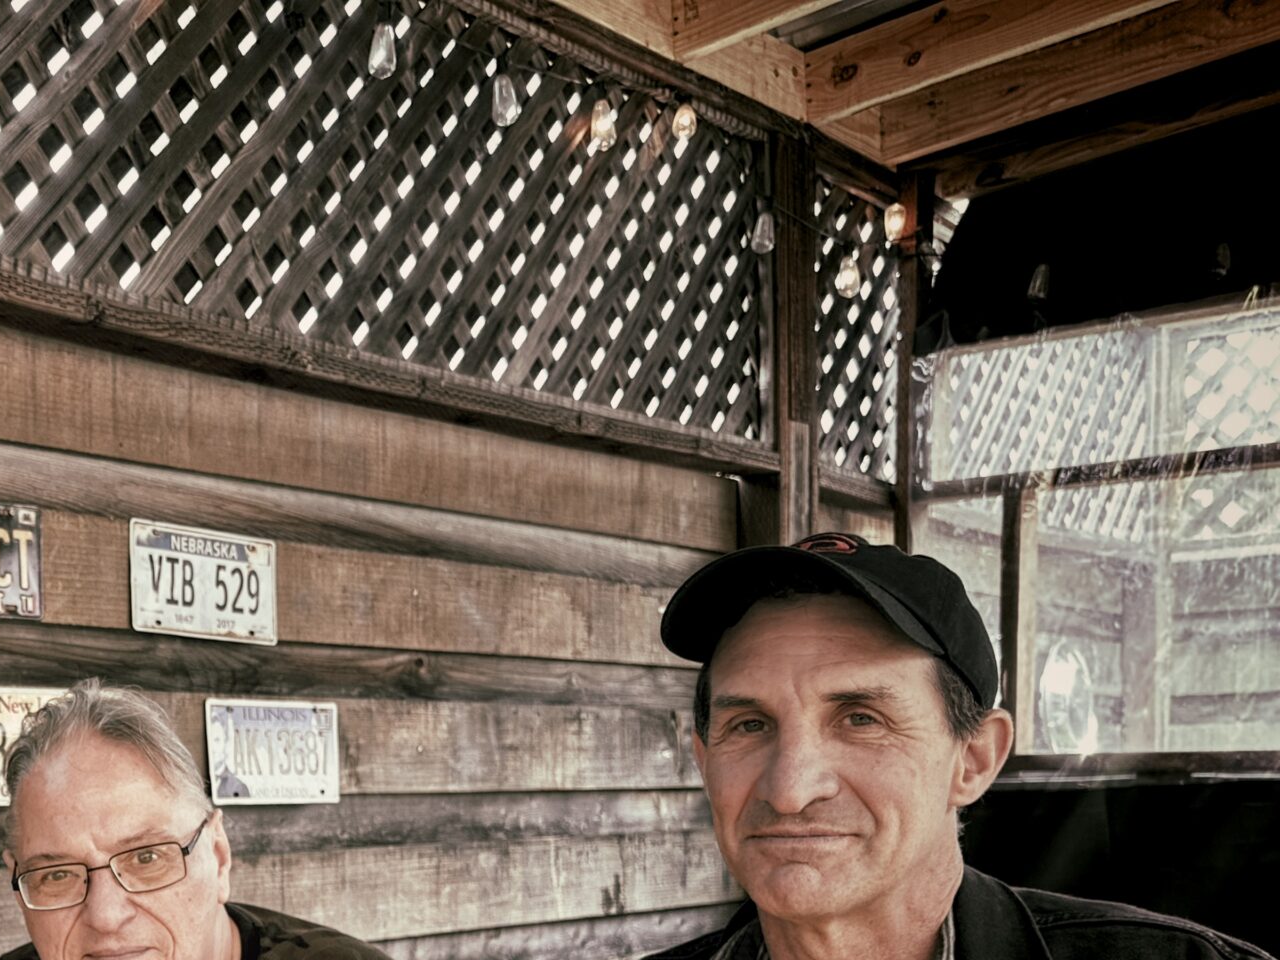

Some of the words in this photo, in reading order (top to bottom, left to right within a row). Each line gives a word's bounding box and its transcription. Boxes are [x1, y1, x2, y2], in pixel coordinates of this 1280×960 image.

[171, 535, 238, 559] NEBRASKA
[149, 554, 195, 607] VIB
[215, 564, 259, 615] 529
[242, 707, 307, 722] ILLINOIS
